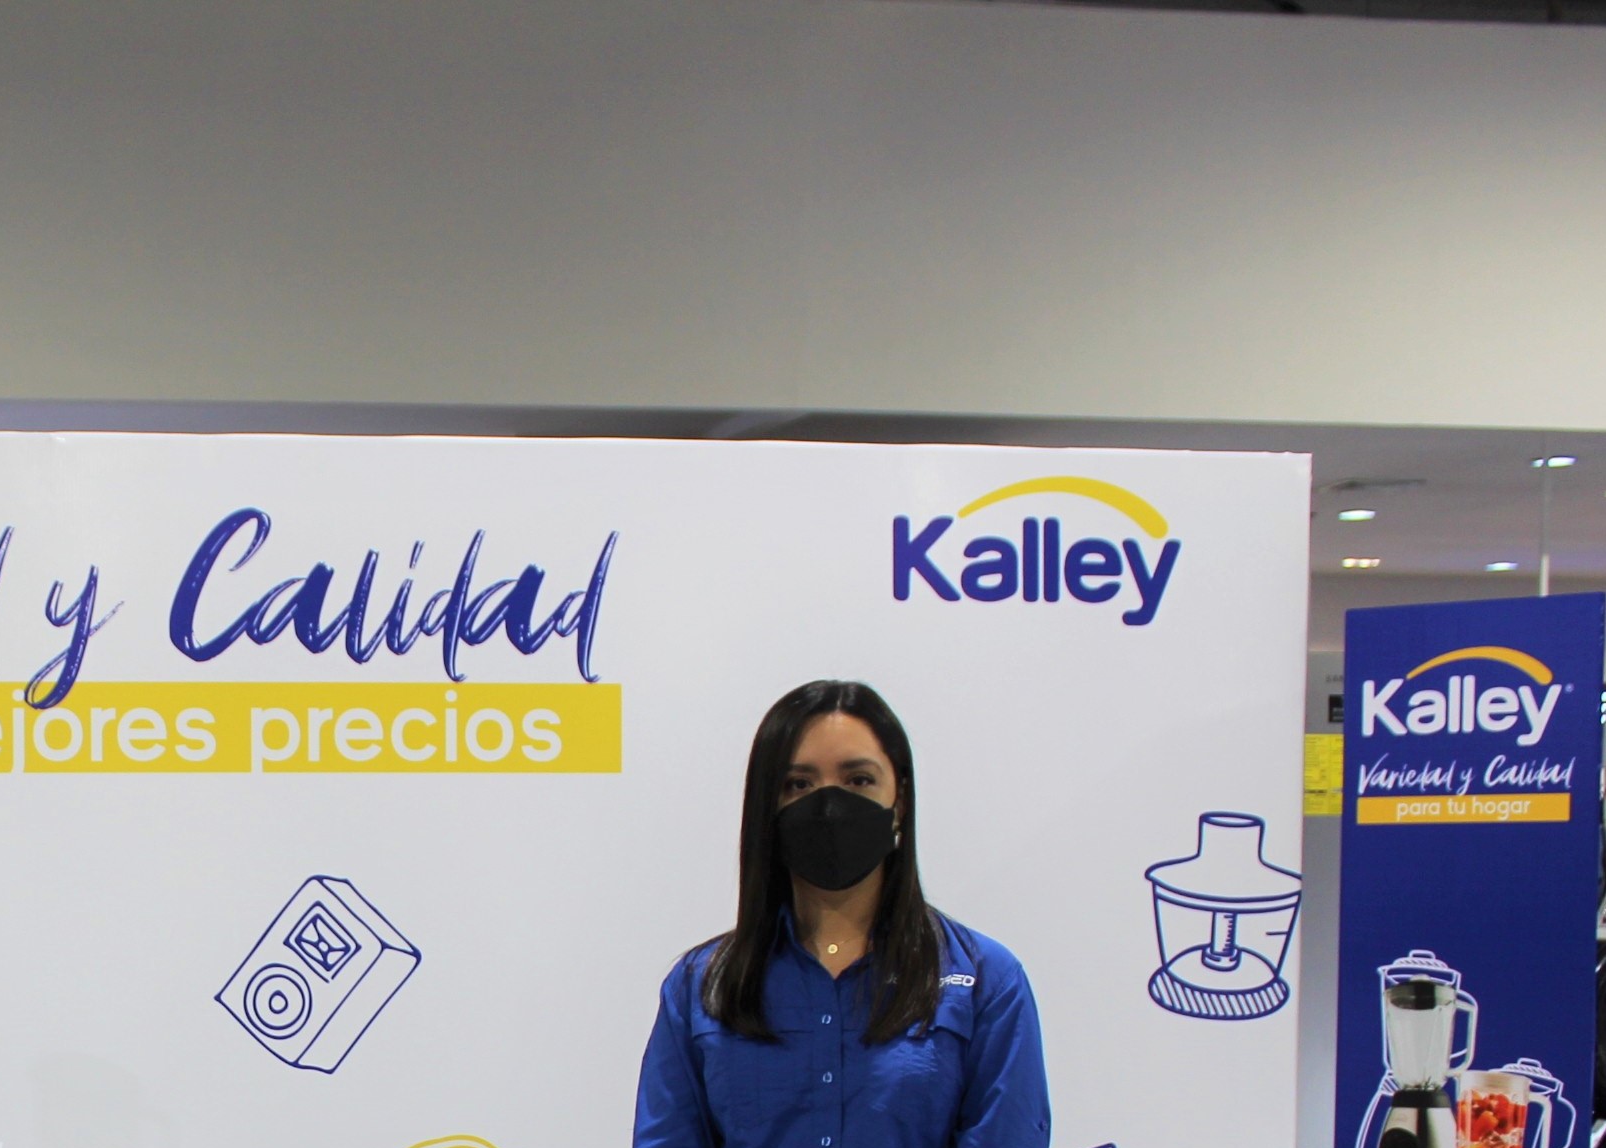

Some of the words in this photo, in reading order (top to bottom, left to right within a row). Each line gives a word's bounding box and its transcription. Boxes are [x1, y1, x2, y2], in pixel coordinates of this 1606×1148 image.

[892, 514, 1181, 626] Kalley
[24, 563, 126, 710] y
[168, 507, 619, 682] Calidad
[250, 690, 563, 771] precios
[1360, 674, 1561, 746] Kalley
[1357, 753, 1457, 795] Variedad
[1456, 767, 1475, 796] y
[1482, 754, 1577, 790] Calidad
[1396, 801, 1441, 820] para
[1447, 796, 1467, 815] tu
[1471, 796, 1532, 821] hogar
